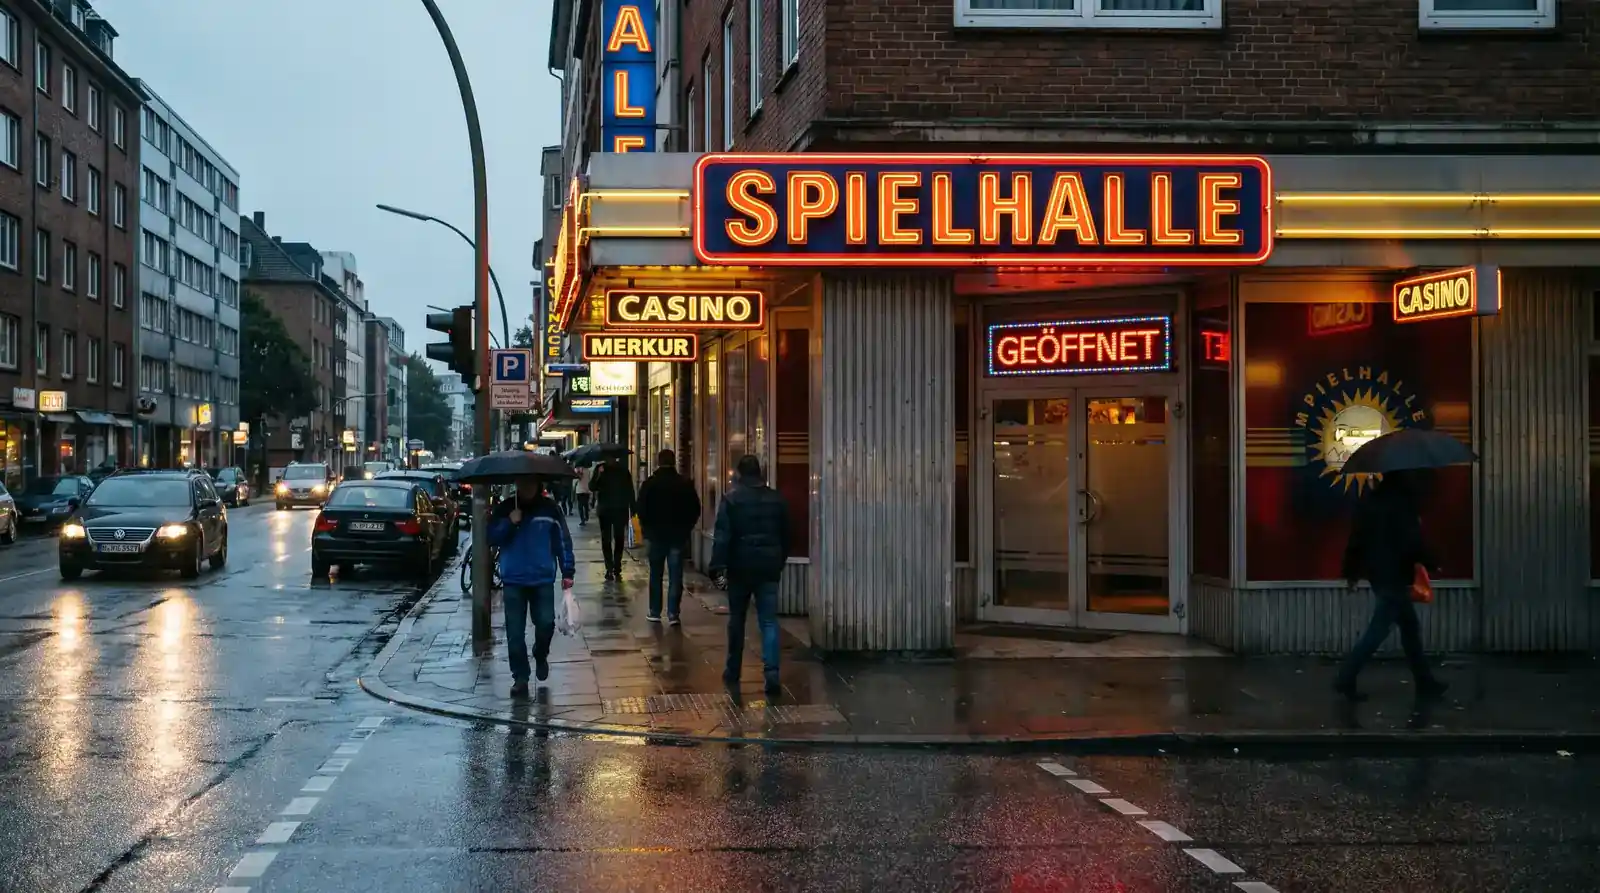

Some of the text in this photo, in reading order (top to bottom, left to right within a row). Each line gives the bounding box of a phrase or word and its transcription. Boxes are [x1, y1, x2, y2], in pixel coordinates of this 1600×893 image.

[725, 170, 1243, 246] SPIELHALLE
[617, 295, 752, 322] CASINO
[1398, 277, 1470, 315] CASINO
[591, 338, 689, 357] MERKUR
[996, 328, 1160, 366] GEÖFFNET
[503, 356, 519, 378] P
